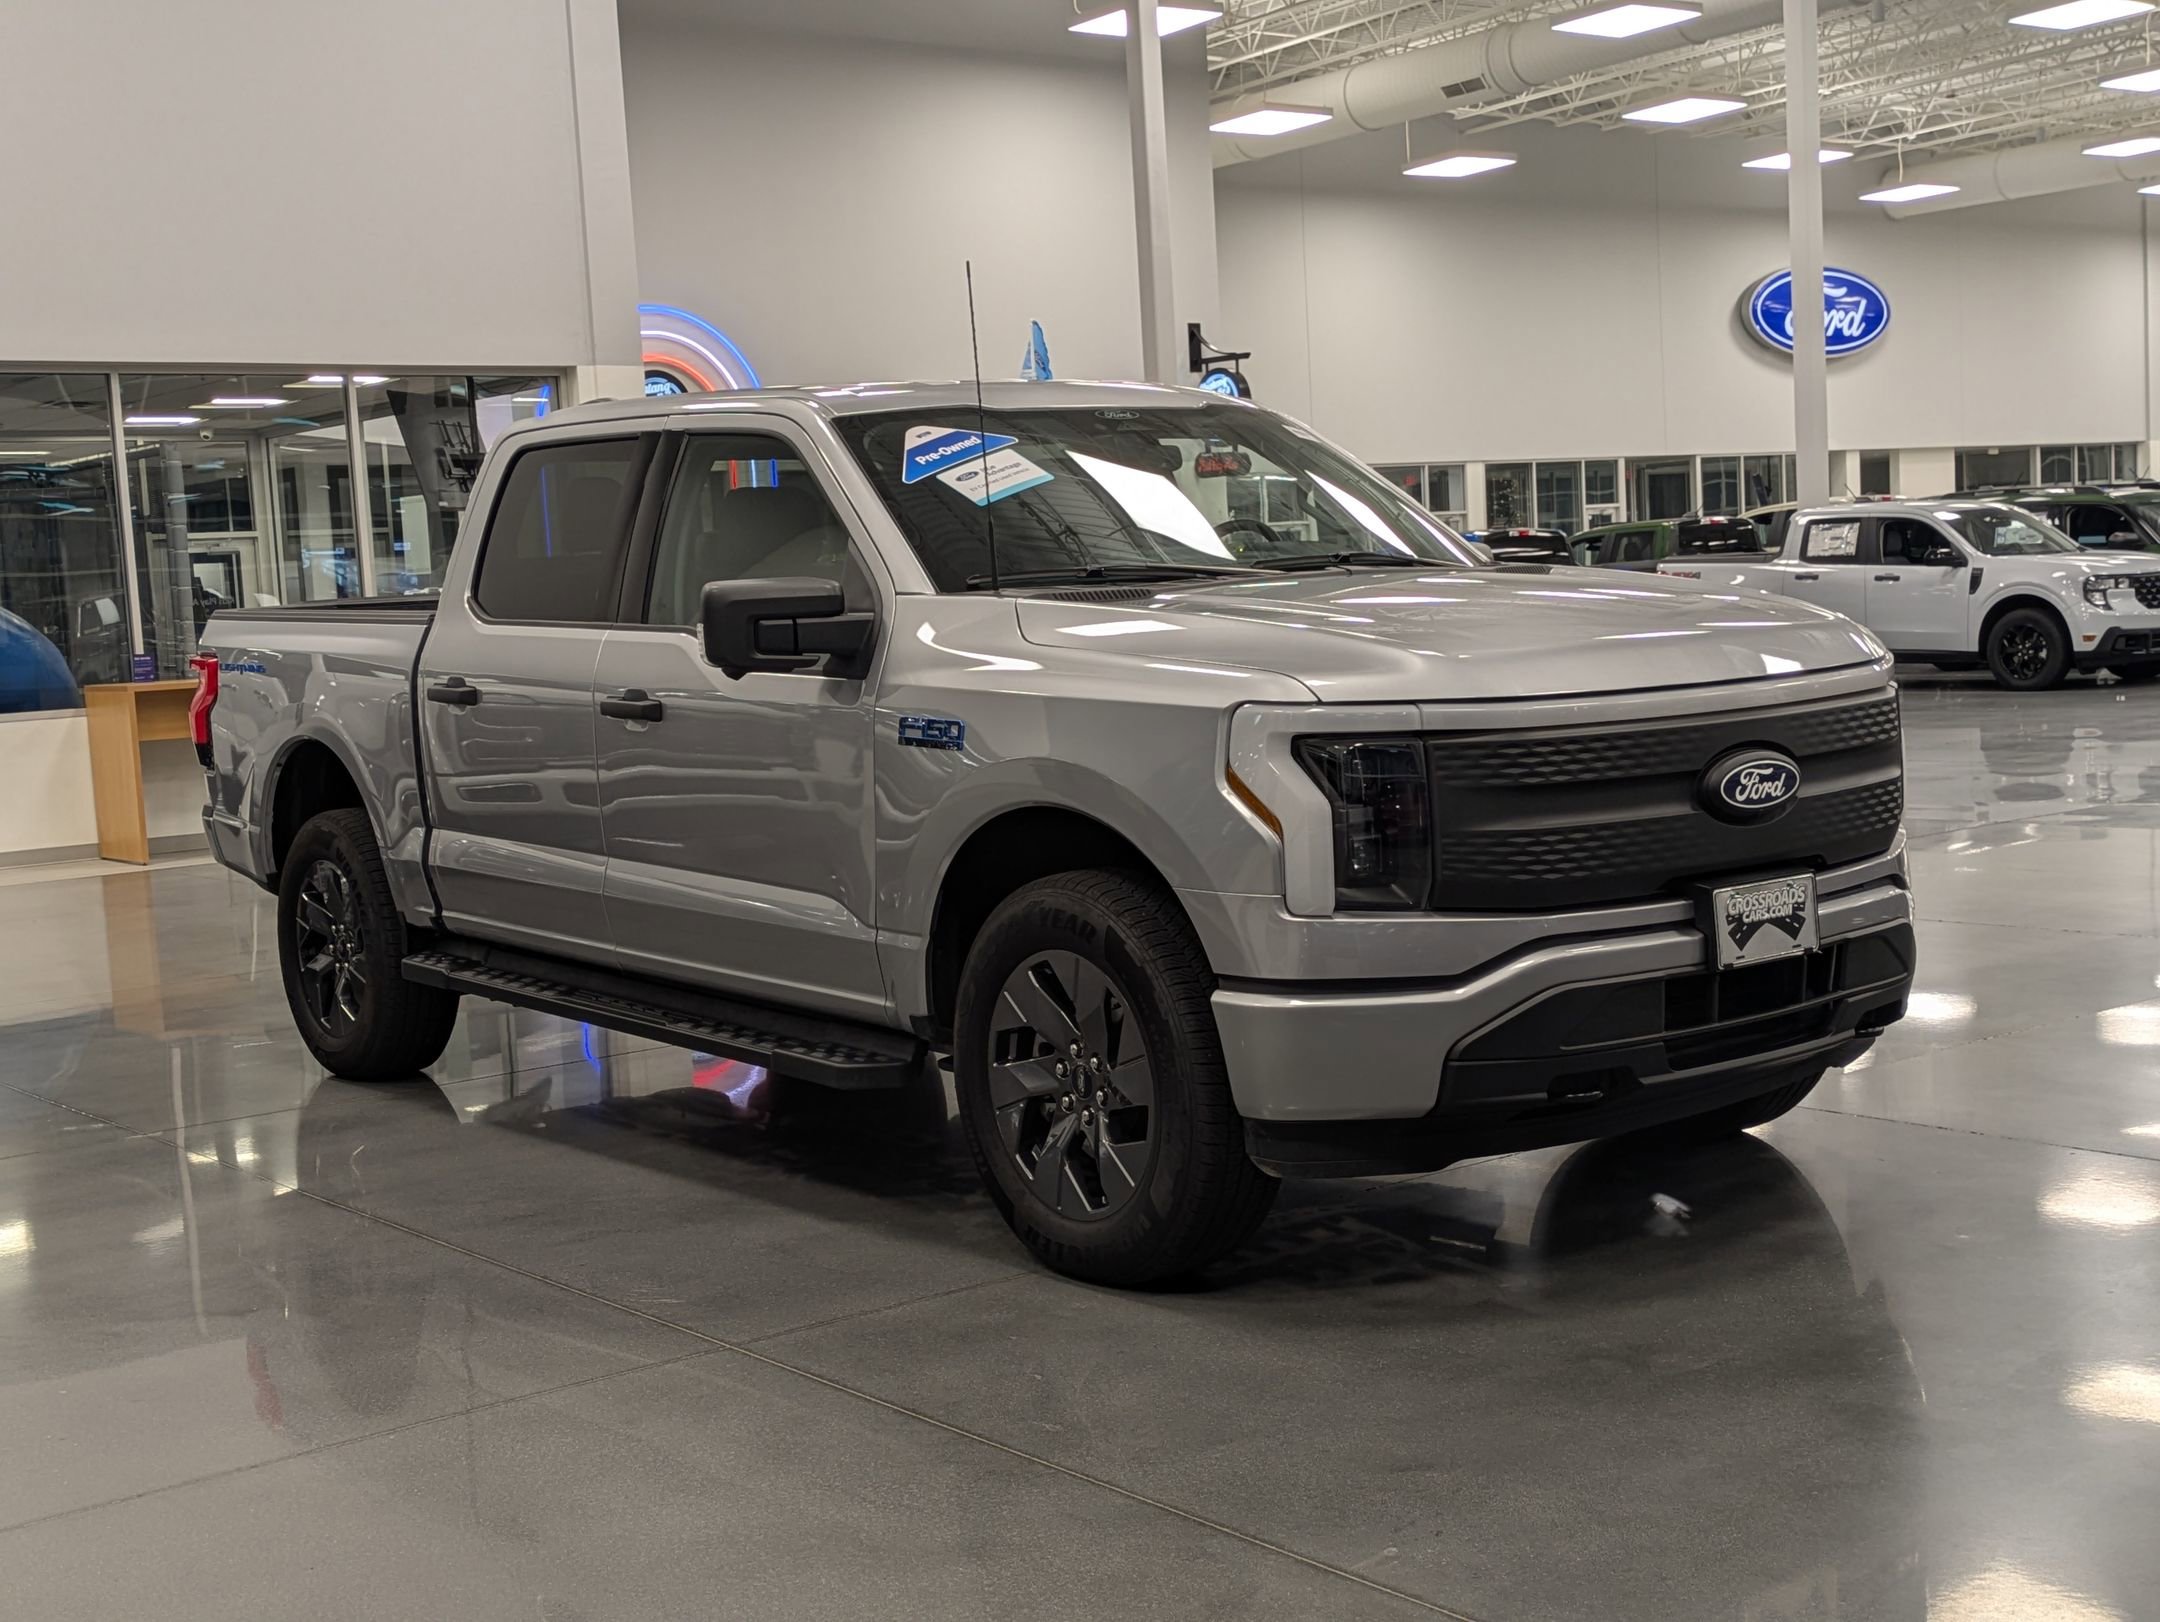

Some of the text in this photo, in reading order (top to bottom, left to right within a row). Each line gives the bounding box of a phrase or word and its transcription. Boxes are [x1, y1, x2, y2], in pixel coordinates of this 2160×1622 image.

[914, 435, 982, 465] Pre-Owned
[1735, 767, 1786, 801] Ford
[1727, 886, 1806, 916] CROSSROADS
[1742, 904, 1793, 923] CARS.COM
